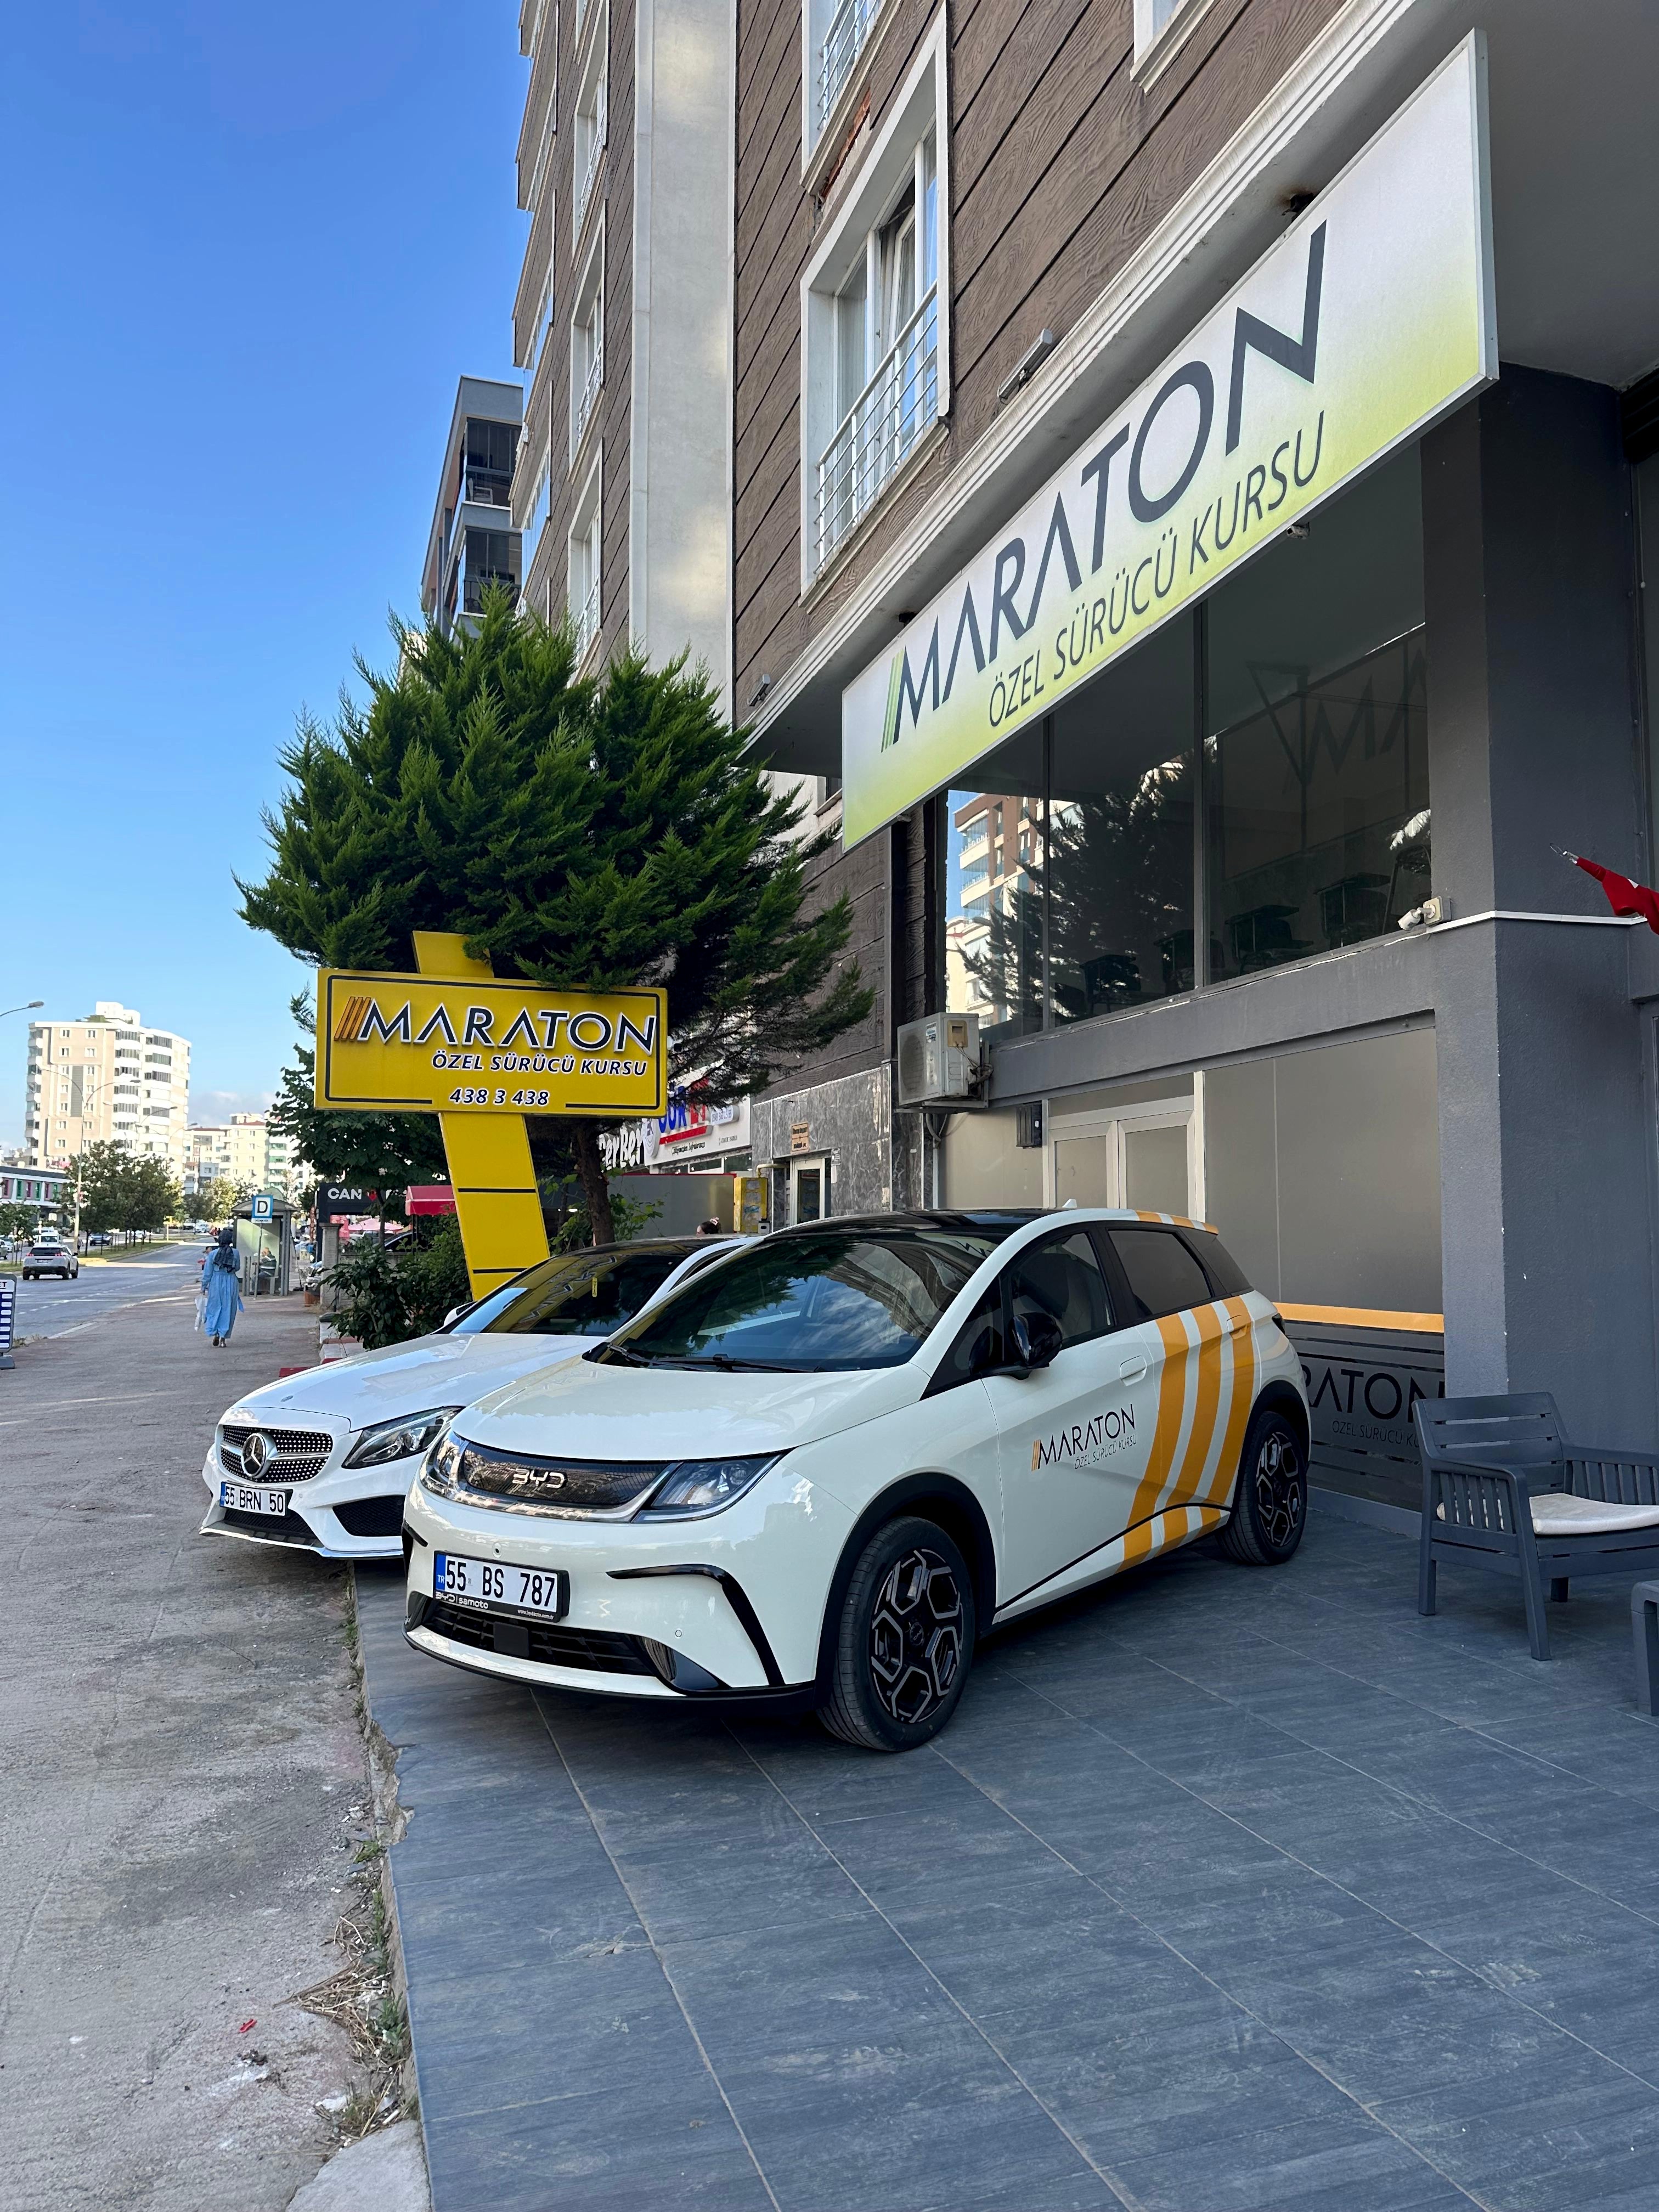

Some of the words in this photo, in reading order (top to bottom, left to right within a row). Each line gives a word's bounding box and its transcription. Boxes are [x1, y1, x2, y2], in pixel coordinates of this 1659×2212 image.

[893, 219, 1327, 744] MARATON
[989, 650, 1044, 727] ÖZEL
[1054, 527, 1177, 680] SÜRÜCÜ
[1190, 409, 1325, 575] KURSU
[357, 997, 657, 1056] MARATON
[432, 1049, 484, 1071] ÖZEL
[490, 1052, 575, 1074] SÜRÜCÜ
[580, 1059, 648, 1076] KURSU
[449, 1087, 488, 1105] 438
[493, 1089, 505, 1105] 3
[512, 1088, 550, 1107] 438
[257, 1200, 268, 1214] D
[328, 1188, 362, 1200] CAN
[1037, 1403, 1135, 1469] MARATON
[1074, 1454, 1091, 1470] ÖZEL
[1092, 1440, 1117, 1463] SÜRÜCÜ
[1118, 1433, 1137, 1451] KURSU
[512, 1468, 565, 1489] BYD
[225, 1486, 235, 1506] 55
[239, 1489, 261, 1510] BRN
[269, 1493, 284, 1513] 50
[437, 1574, 445, 1584] TR
[446, 1560, 466, 1592] 55
[482, 1566, 504, 1599] BS
[520, 1572, 555, 1607] 787
[435, 1591, 456, 1603] BYD
[458, 1597, 489, 1610] samoto
